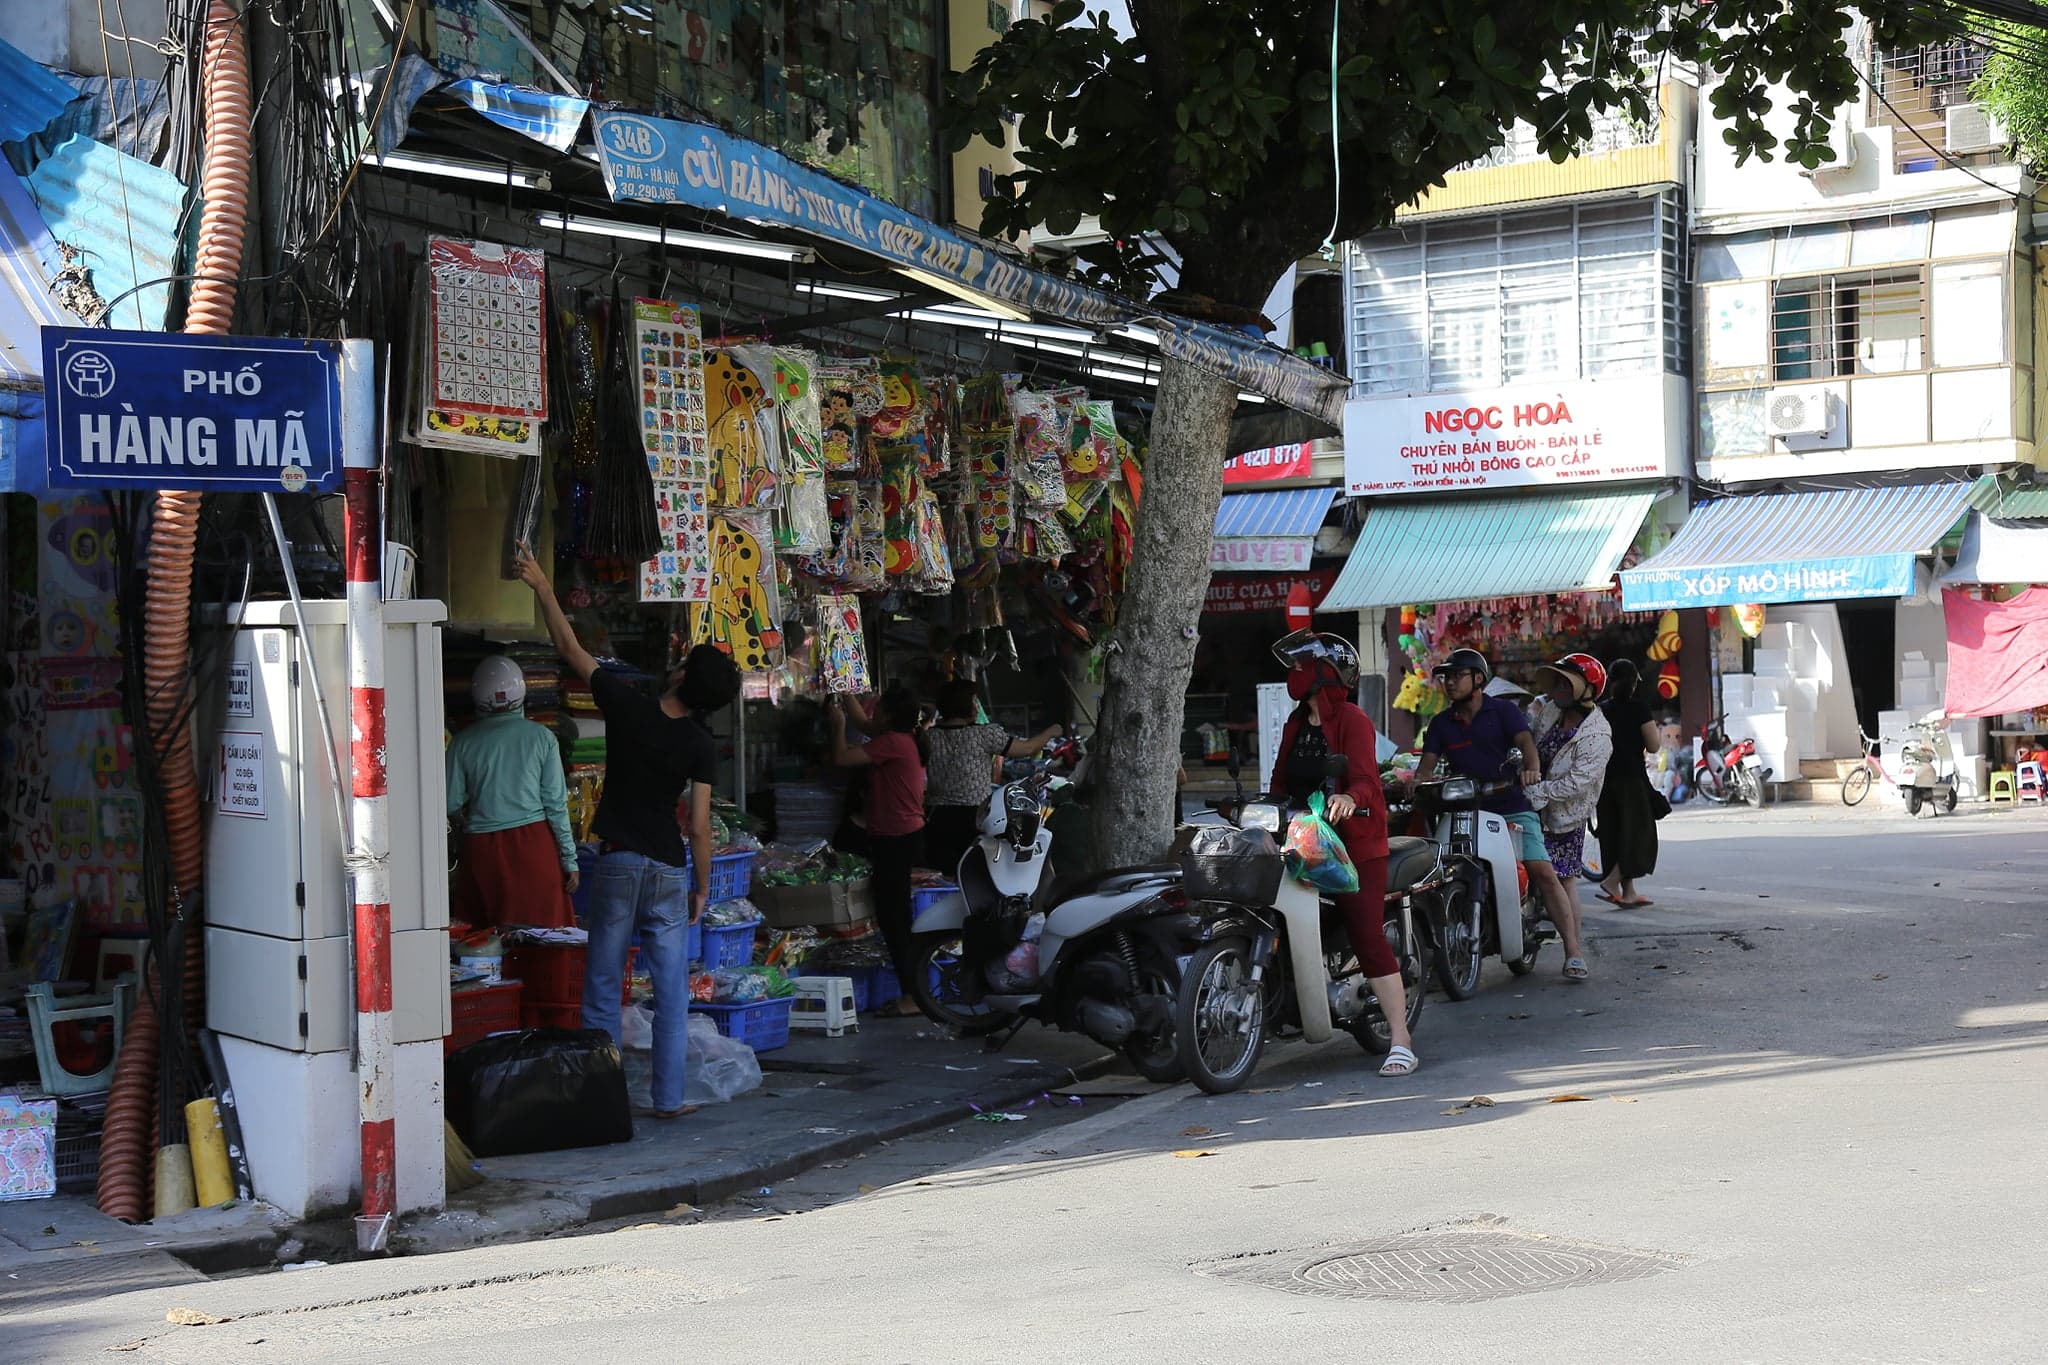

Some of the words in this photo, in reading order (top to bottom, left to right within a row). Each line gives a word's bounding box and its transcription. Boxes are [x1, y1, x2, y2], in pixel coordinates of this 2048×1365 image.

[610, 123, 651, 155] 34B
[183, 362, 263, 396] PHỐ
[1425, 406, 1503, 437] NGỌC
[1513, 393, 1573, 427] HOÀ
[79, 402, 218, 466] HÀNG
[235, 410, 312, 467] MÃ
[1243, 448, 1270, 467] 420
[1274, 442, 1302, 465] 878
[1400, 440, 1457, 458] CHUYÊN
[1462, 439, 1491, 455] BÁN
[1411, 460, 1437, 475] THÚ
[1443, 455, 1475, 473] NHỒI
[1480, 456, 1520, 472] BÔNG
[1525, 456, 1556, 468] CAO
[1561, 448, 1591, 466] CẤP
[1211, 540, 1305, 565] GUYỆT
[1276, 577, 1321, 597] HG
[1684, 571, 1732, 598] XỐP
[1738, 570, 1778, 594] MÔ
